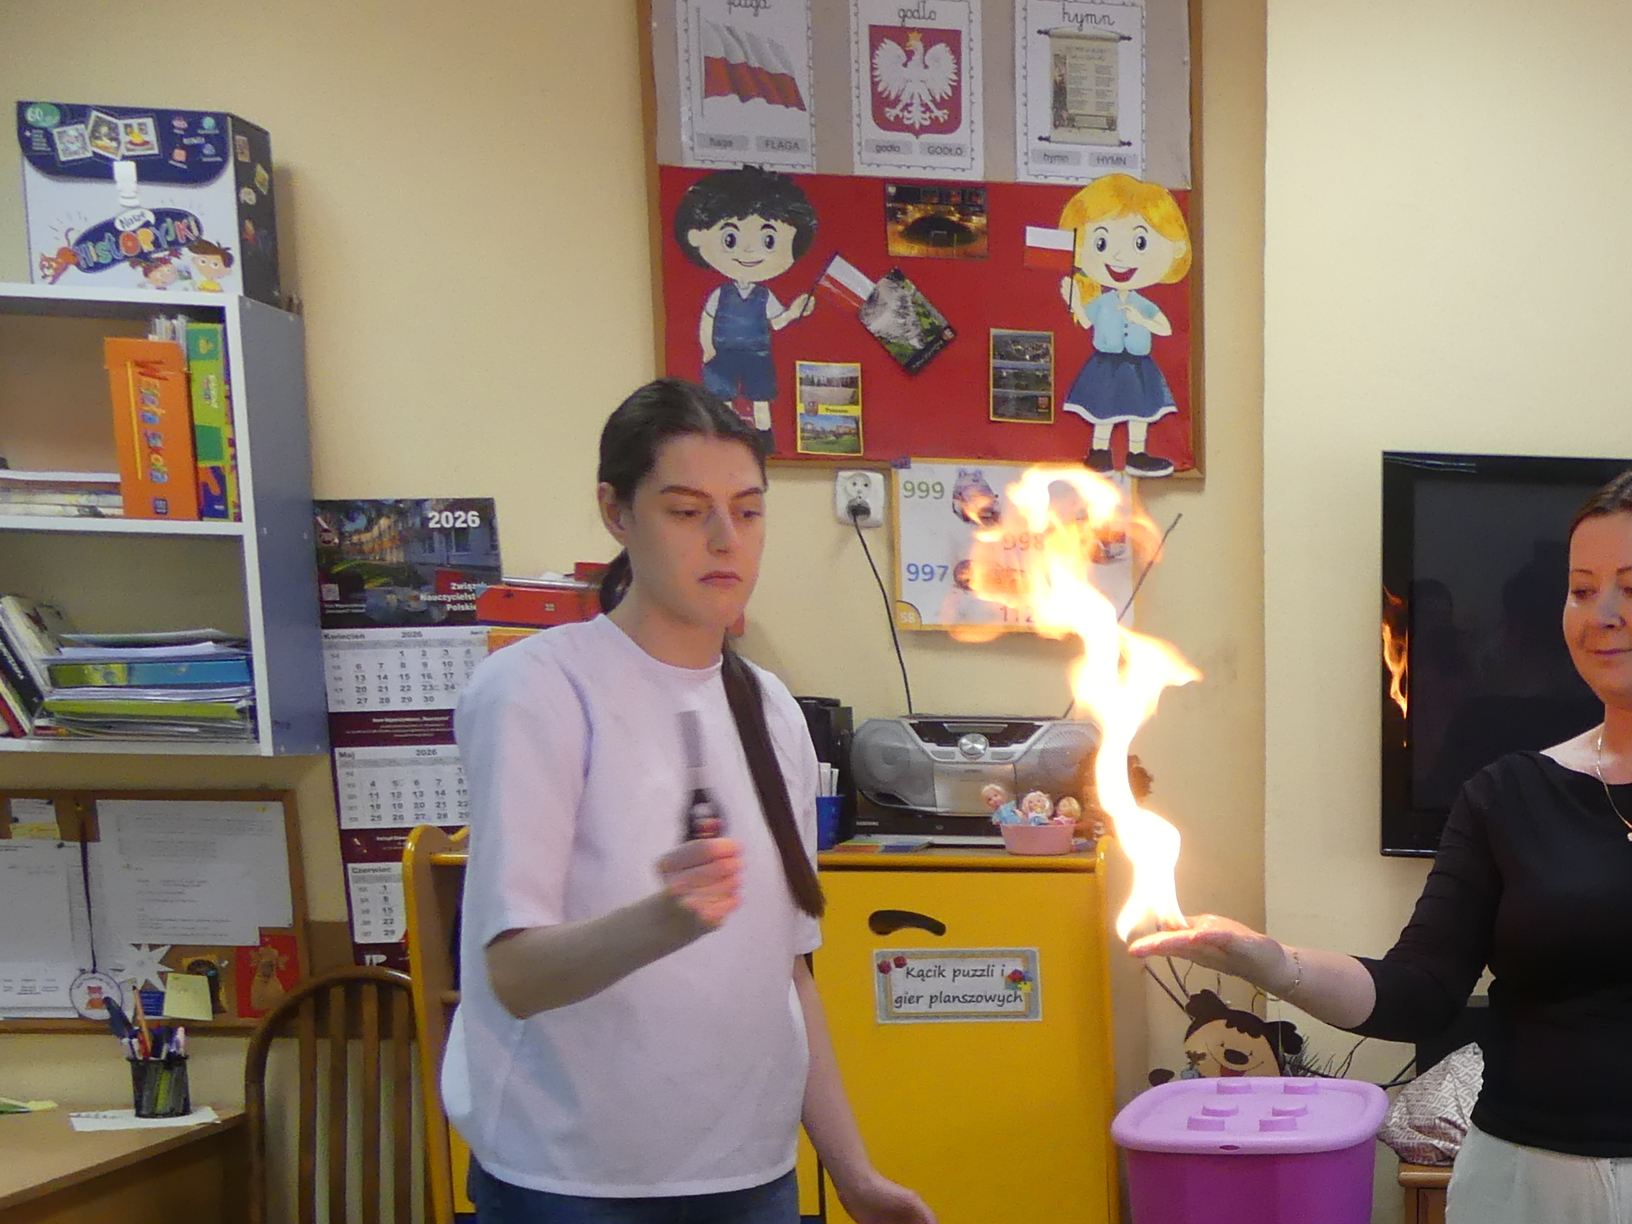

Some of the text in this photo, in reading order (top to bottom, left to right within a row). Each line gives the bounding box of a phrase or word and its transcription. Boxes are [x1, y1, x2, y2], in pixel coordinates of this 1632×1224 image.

[898, 1, 937, 26] godło
[1062, 3, 1115, 31] hymn
[765, 139, 800, 151] FLAGA
[1097, 155, 1127, 166] HYMN
[903, 481, 945, 500] 999
[428, 510, 481, 529] 2026
[1003, 532, 1045, 551] 998
[906, 563, 949, 582] 997
[905, 964, 1006, 982] Kącik puzzli i
[894, 991, 1023, 1009] gier planszowych
